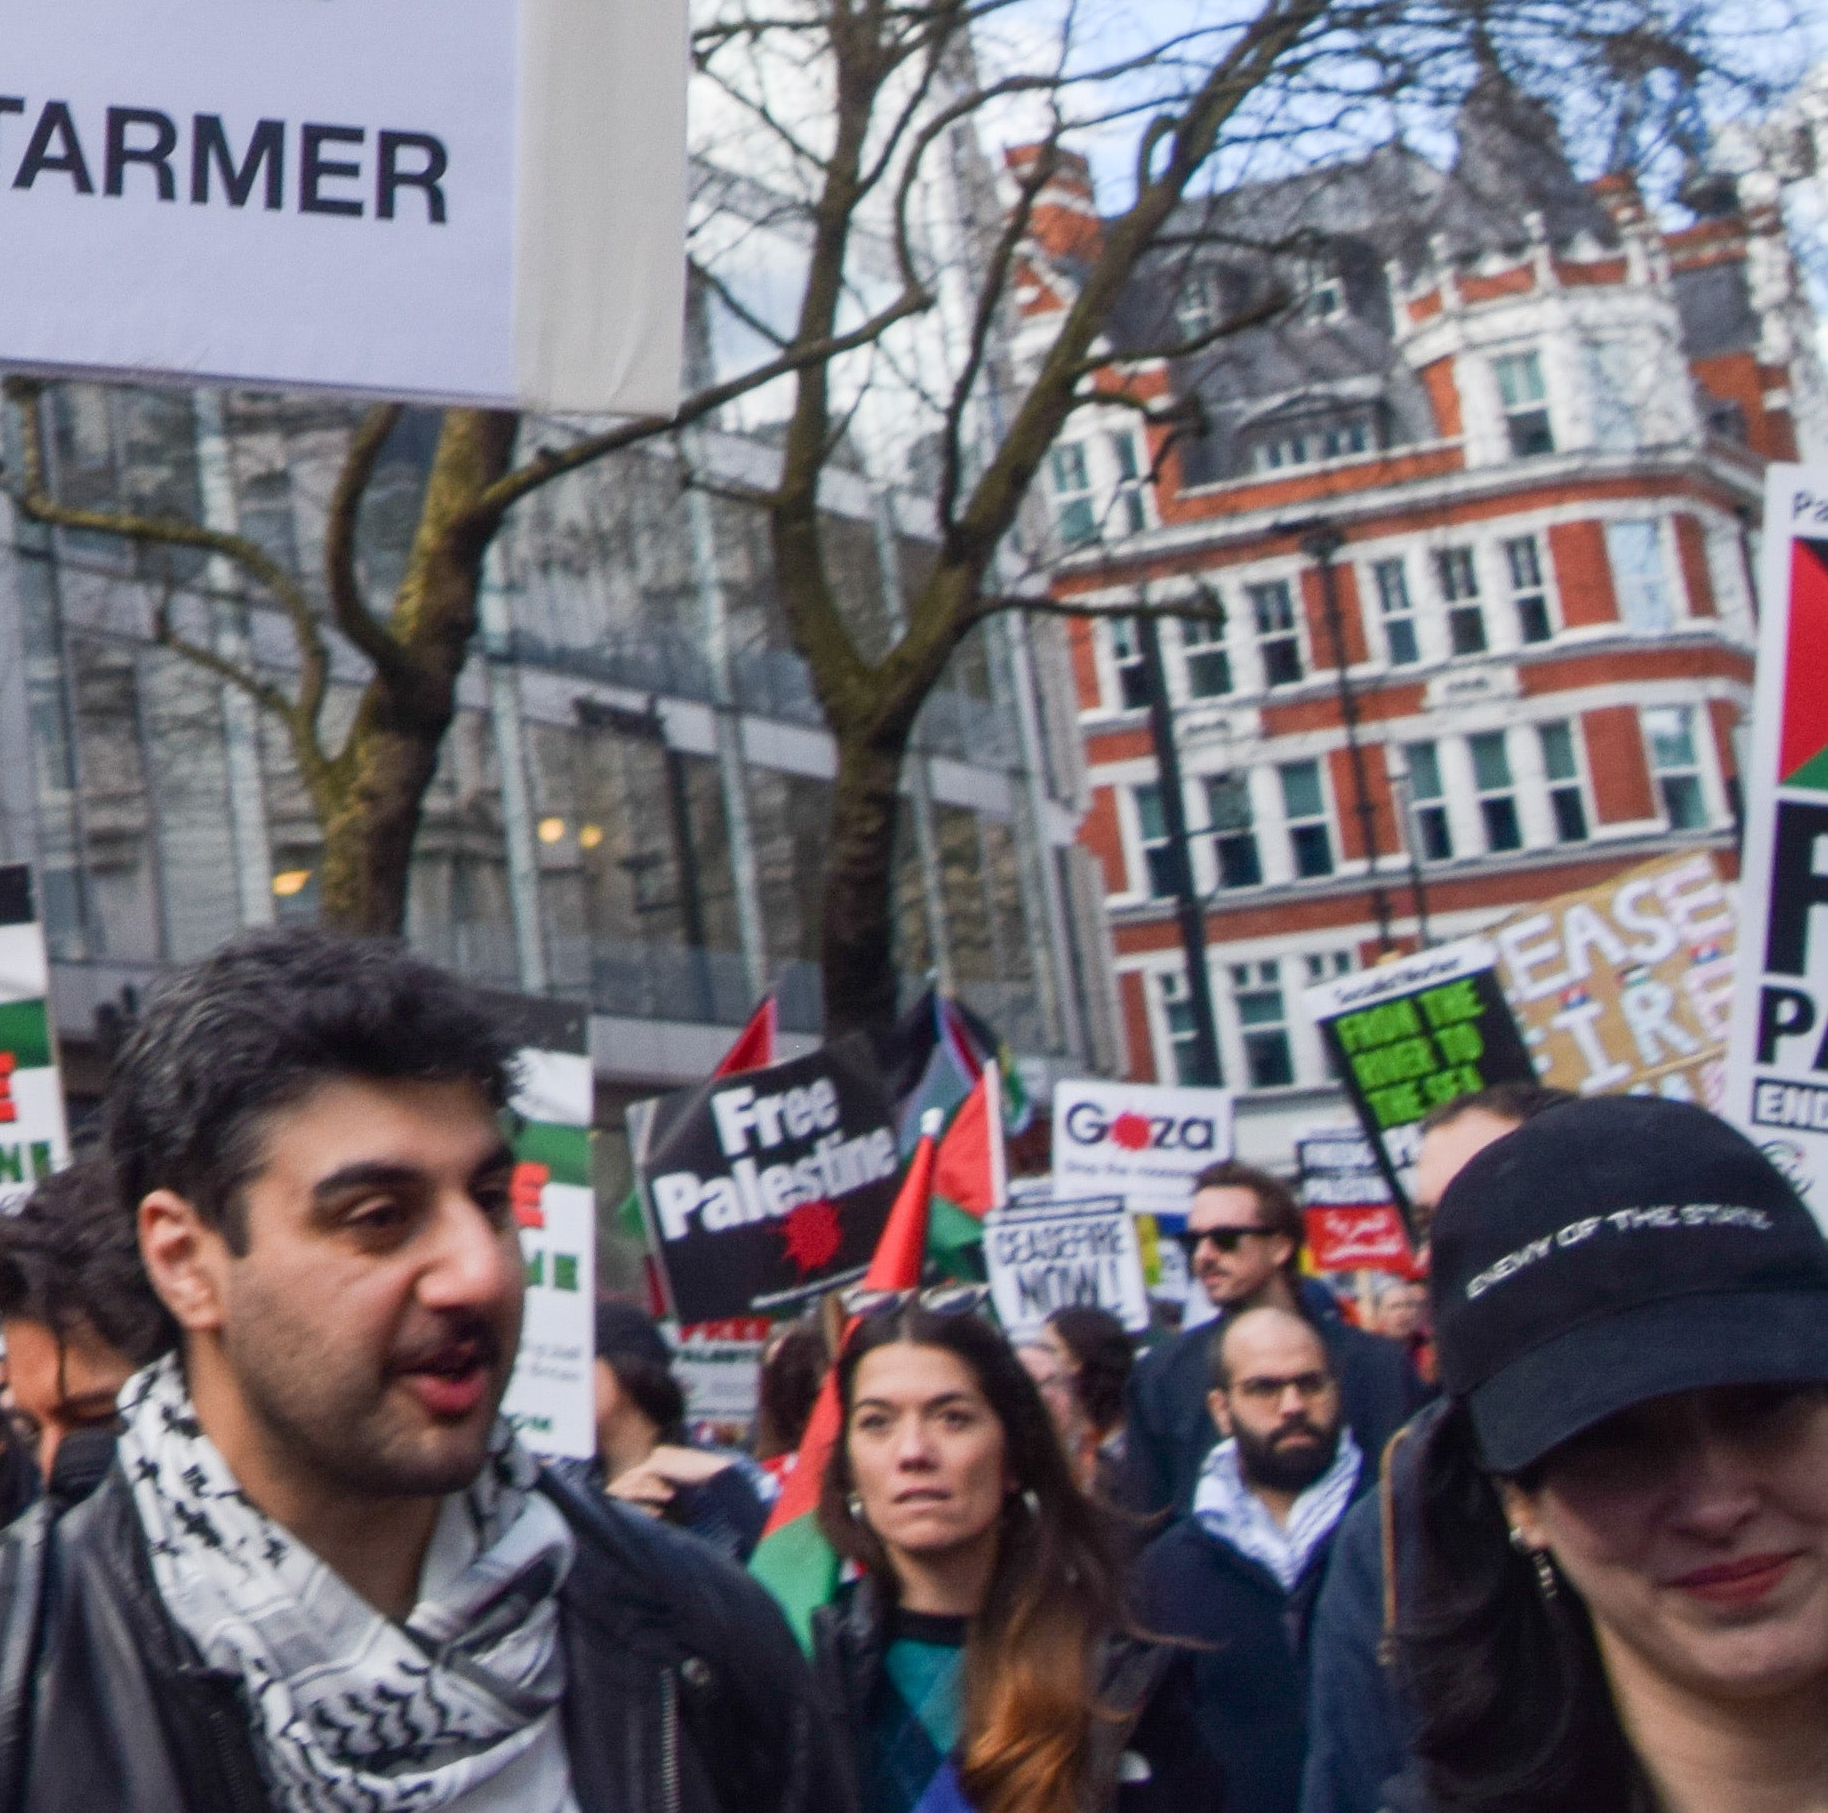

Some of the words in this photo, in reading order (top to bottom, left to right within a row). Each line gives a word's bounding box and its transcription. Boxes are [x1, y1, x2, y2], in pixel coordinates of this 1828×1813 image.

[711, 1078, 840, 1156] Free
[652, 1125, 900, 1243] Palestine
[1556, 1215, 1603, 1248] OF
[1605, 1205, 1679, 1232] THE
